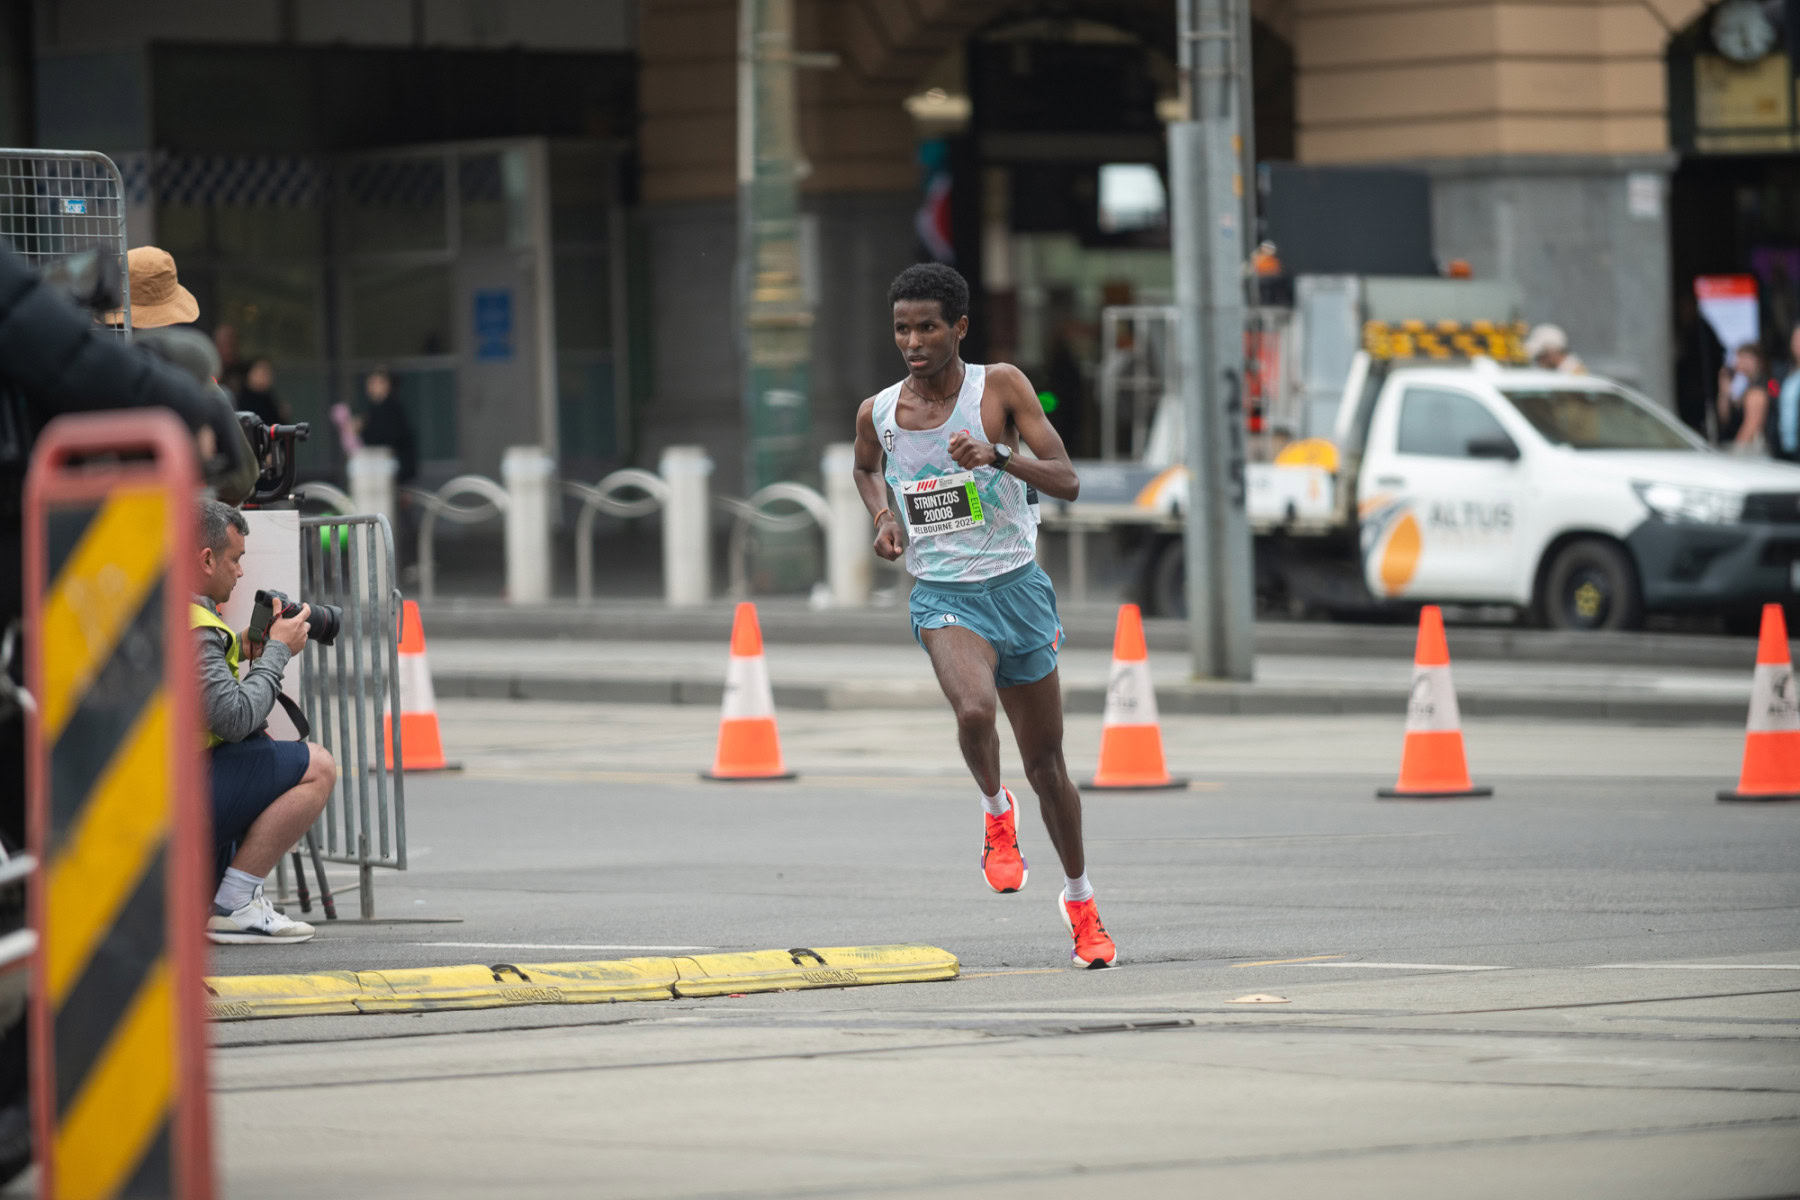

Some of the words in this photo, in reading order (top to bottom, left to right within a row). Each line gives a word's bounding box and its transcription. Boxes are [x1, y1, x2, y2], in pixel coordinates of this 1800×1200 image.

[913, 490, 960, 510] STRINTZOS
[970, 497, 983, 520] ELITE
[924, 506, 953, 523] 20008
[1427, 500, 1514, 530] ALTUS
[913, 521, 953, 534] MELBOURNE
